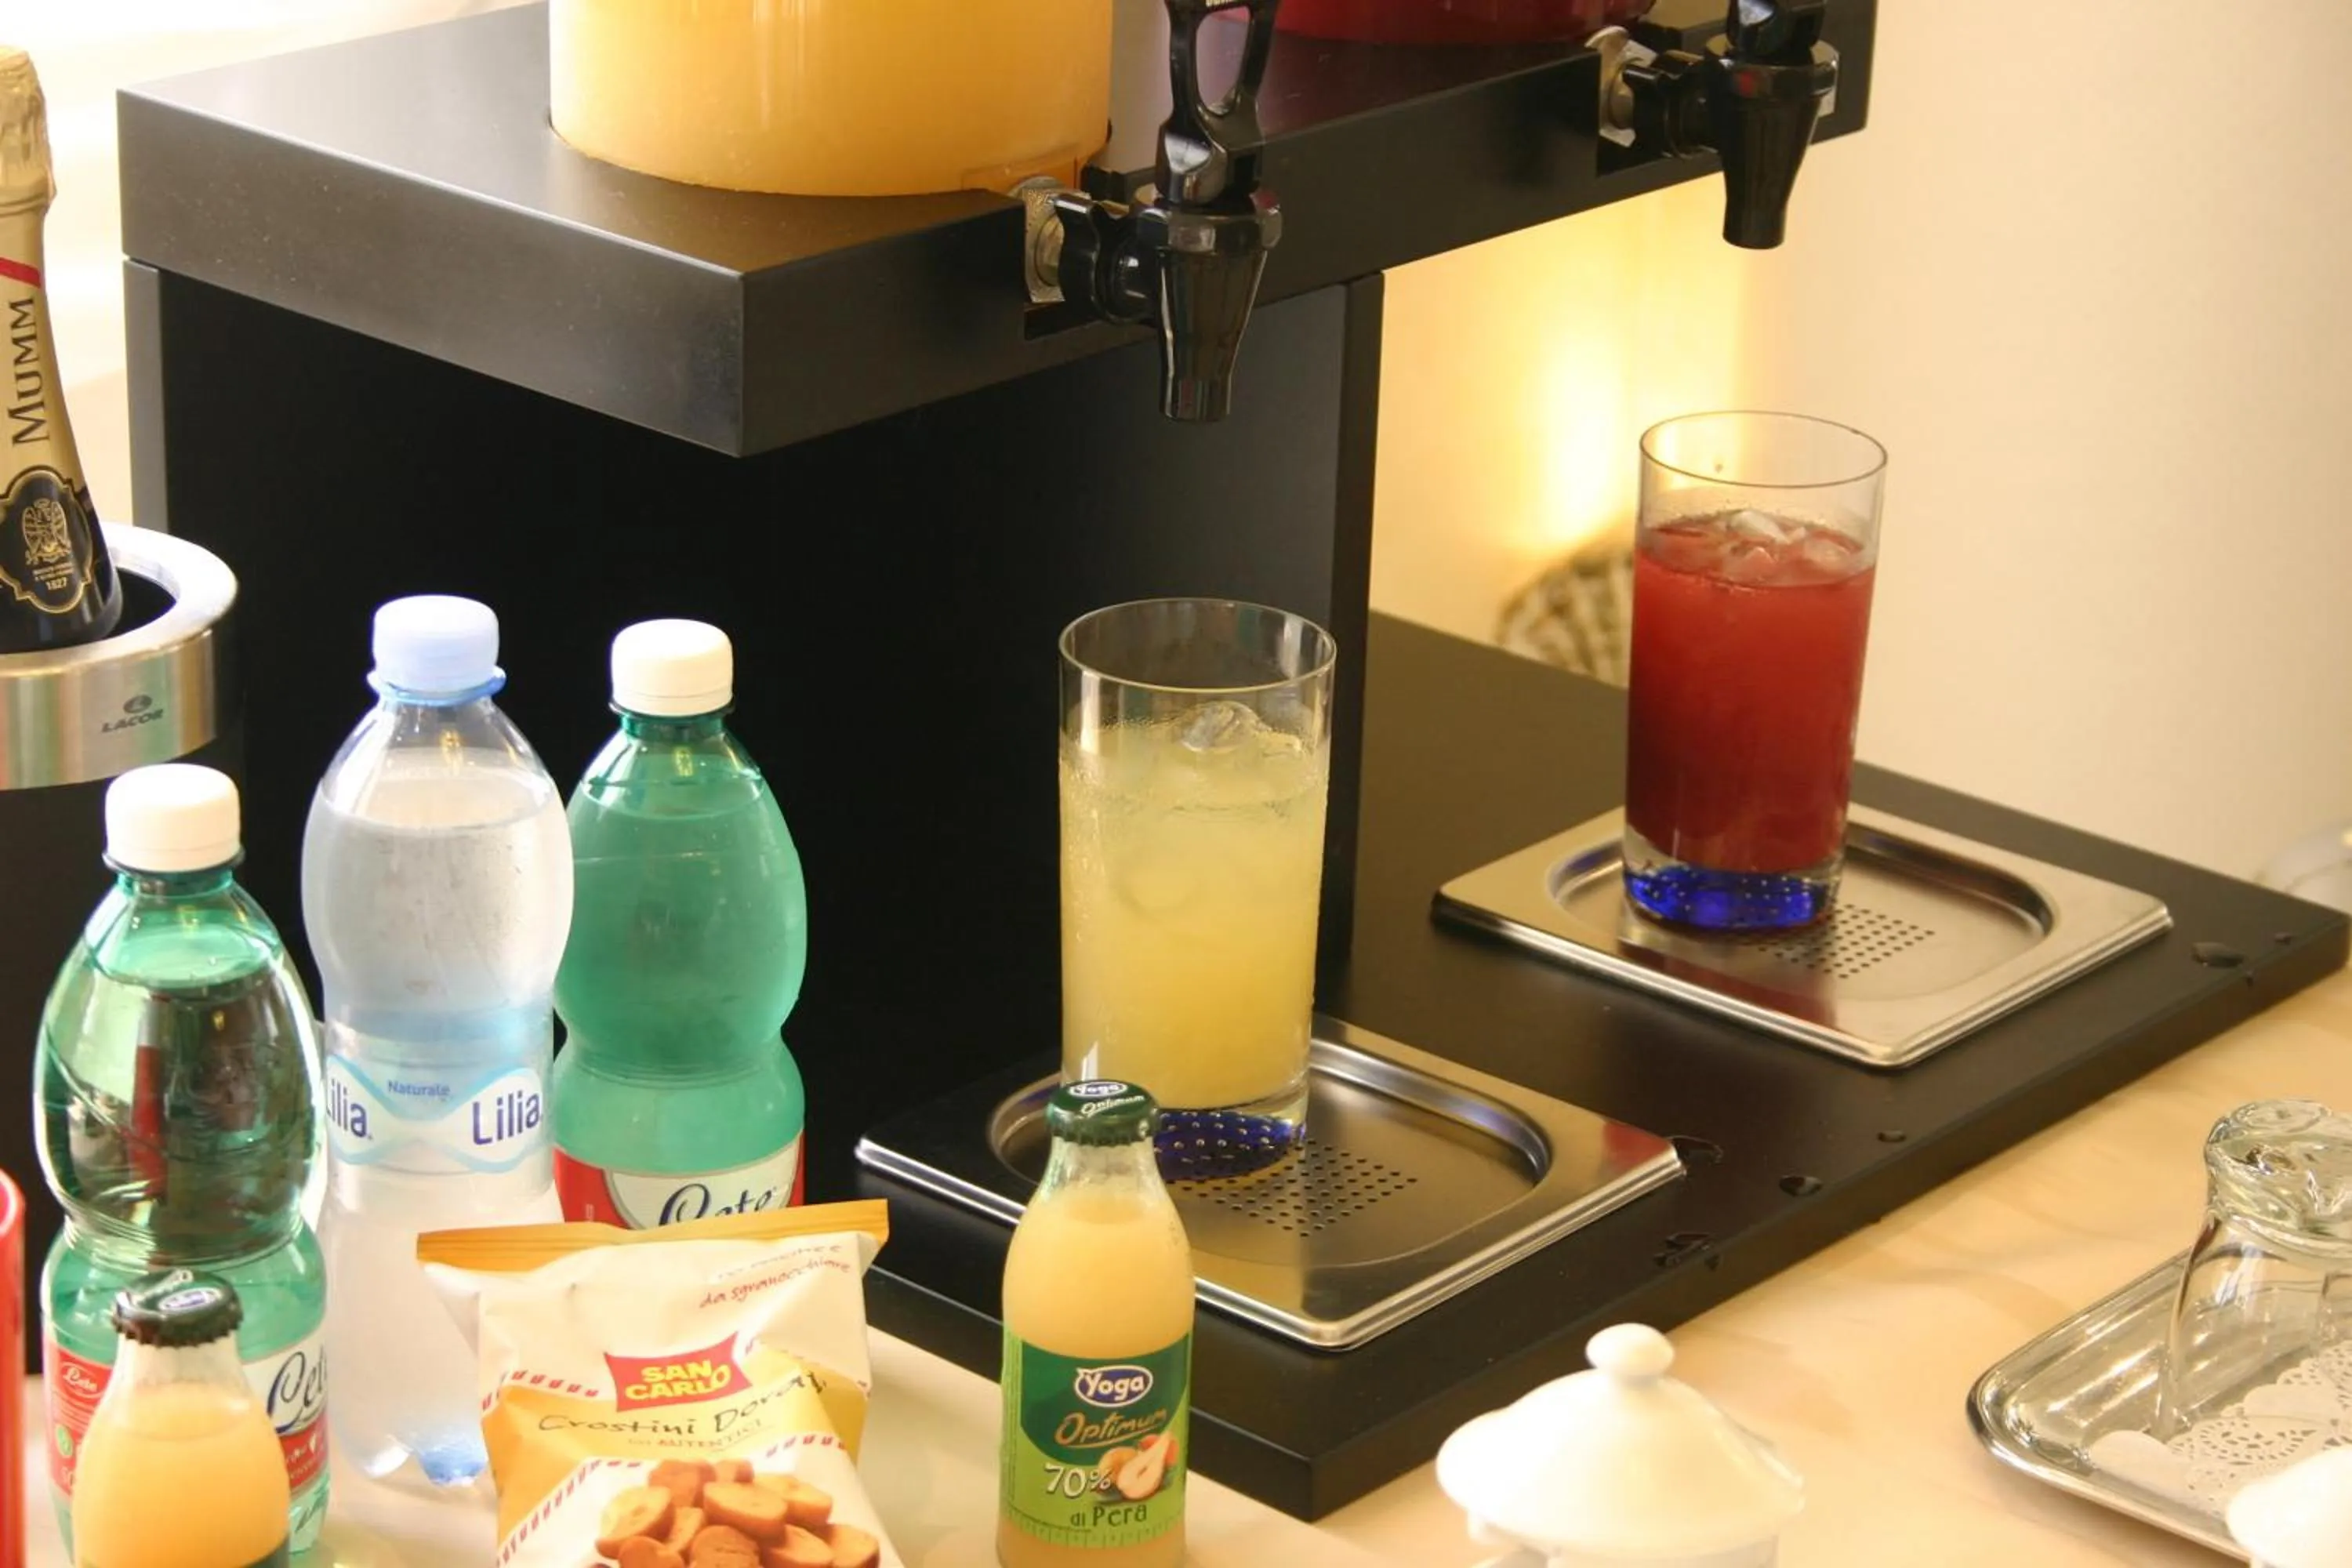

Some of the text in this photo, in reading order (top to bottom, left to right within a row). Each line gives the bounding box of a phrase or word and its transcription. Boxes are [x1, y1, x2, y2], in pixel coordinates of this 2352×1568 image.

[101, 709, 163, 733] LACOR
[387, 1080, 451, 1096] Naturale
[325, 1078, 367, 1138] ilia
[472, 1090, 541, 1145] Lilia
[699, 1291, 727, 1308] da
[624, 1364, 731, 1401] CARLO
[641, 1359, 713, 1382] SAN
[1084, 1370, 1145, 1401] Yoga
[539, 1414, 698, 1436] Crostini
[1044, 1462, 1112, 1499] 70%
[1070, 1504, 1148, 1527] di Pera
